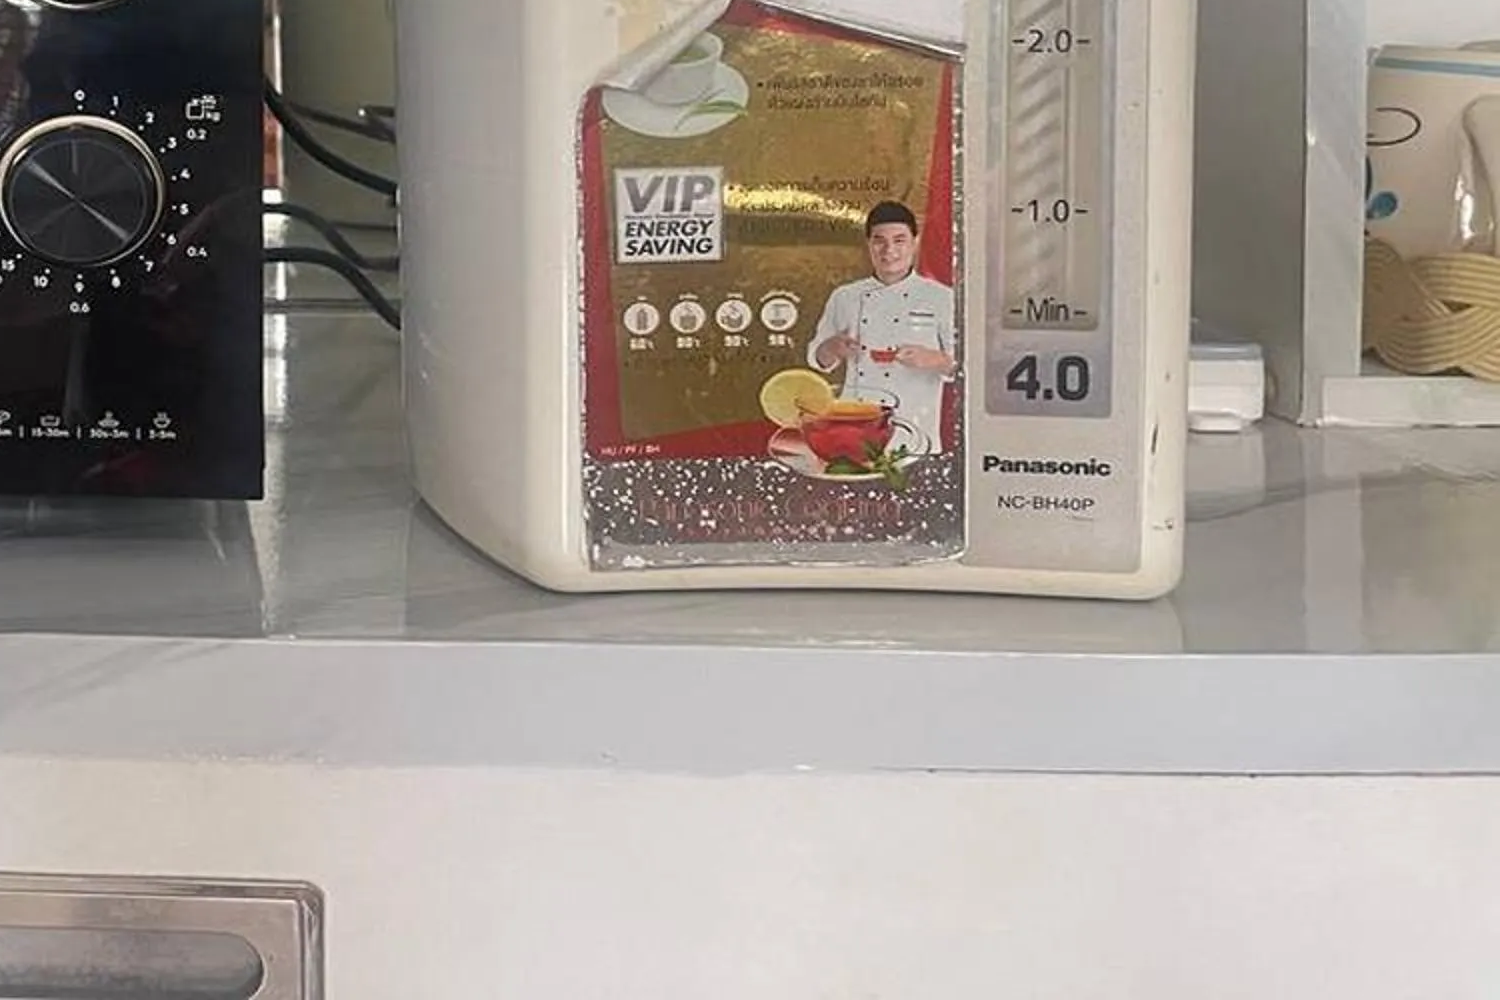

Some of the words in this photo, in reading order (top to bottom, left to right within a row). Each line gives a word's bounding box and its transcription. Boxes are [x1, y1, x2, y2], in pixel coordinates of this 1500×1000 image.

[74, 89, 85, 101] 0
[112, 95, 119, 107] 1
[145, 111, 154, 124] 2
[168, 136, 177, 149] 3
[180, 168, 191, 179] 4
[622, 175, 715, 213] VIP
[180, 203, 189, 215] 5
[625, 219, 714, 238] ENERGY
[166, 234, 177, 245] 6
[625, 238, 714, 256] SAVING
[1, 258, 16, 271] 15
[145, 260, 154, 272] 7
[33, 275, 49, 288] 10
[74, 281, 85, 293] 9
[111, 276, 121, 288] 8
[1006, 355, 1090, 401] 4.0
[983, 455, 1111, 477] Panasonic
[998, 495, 1095, 511] NC-BH40P
